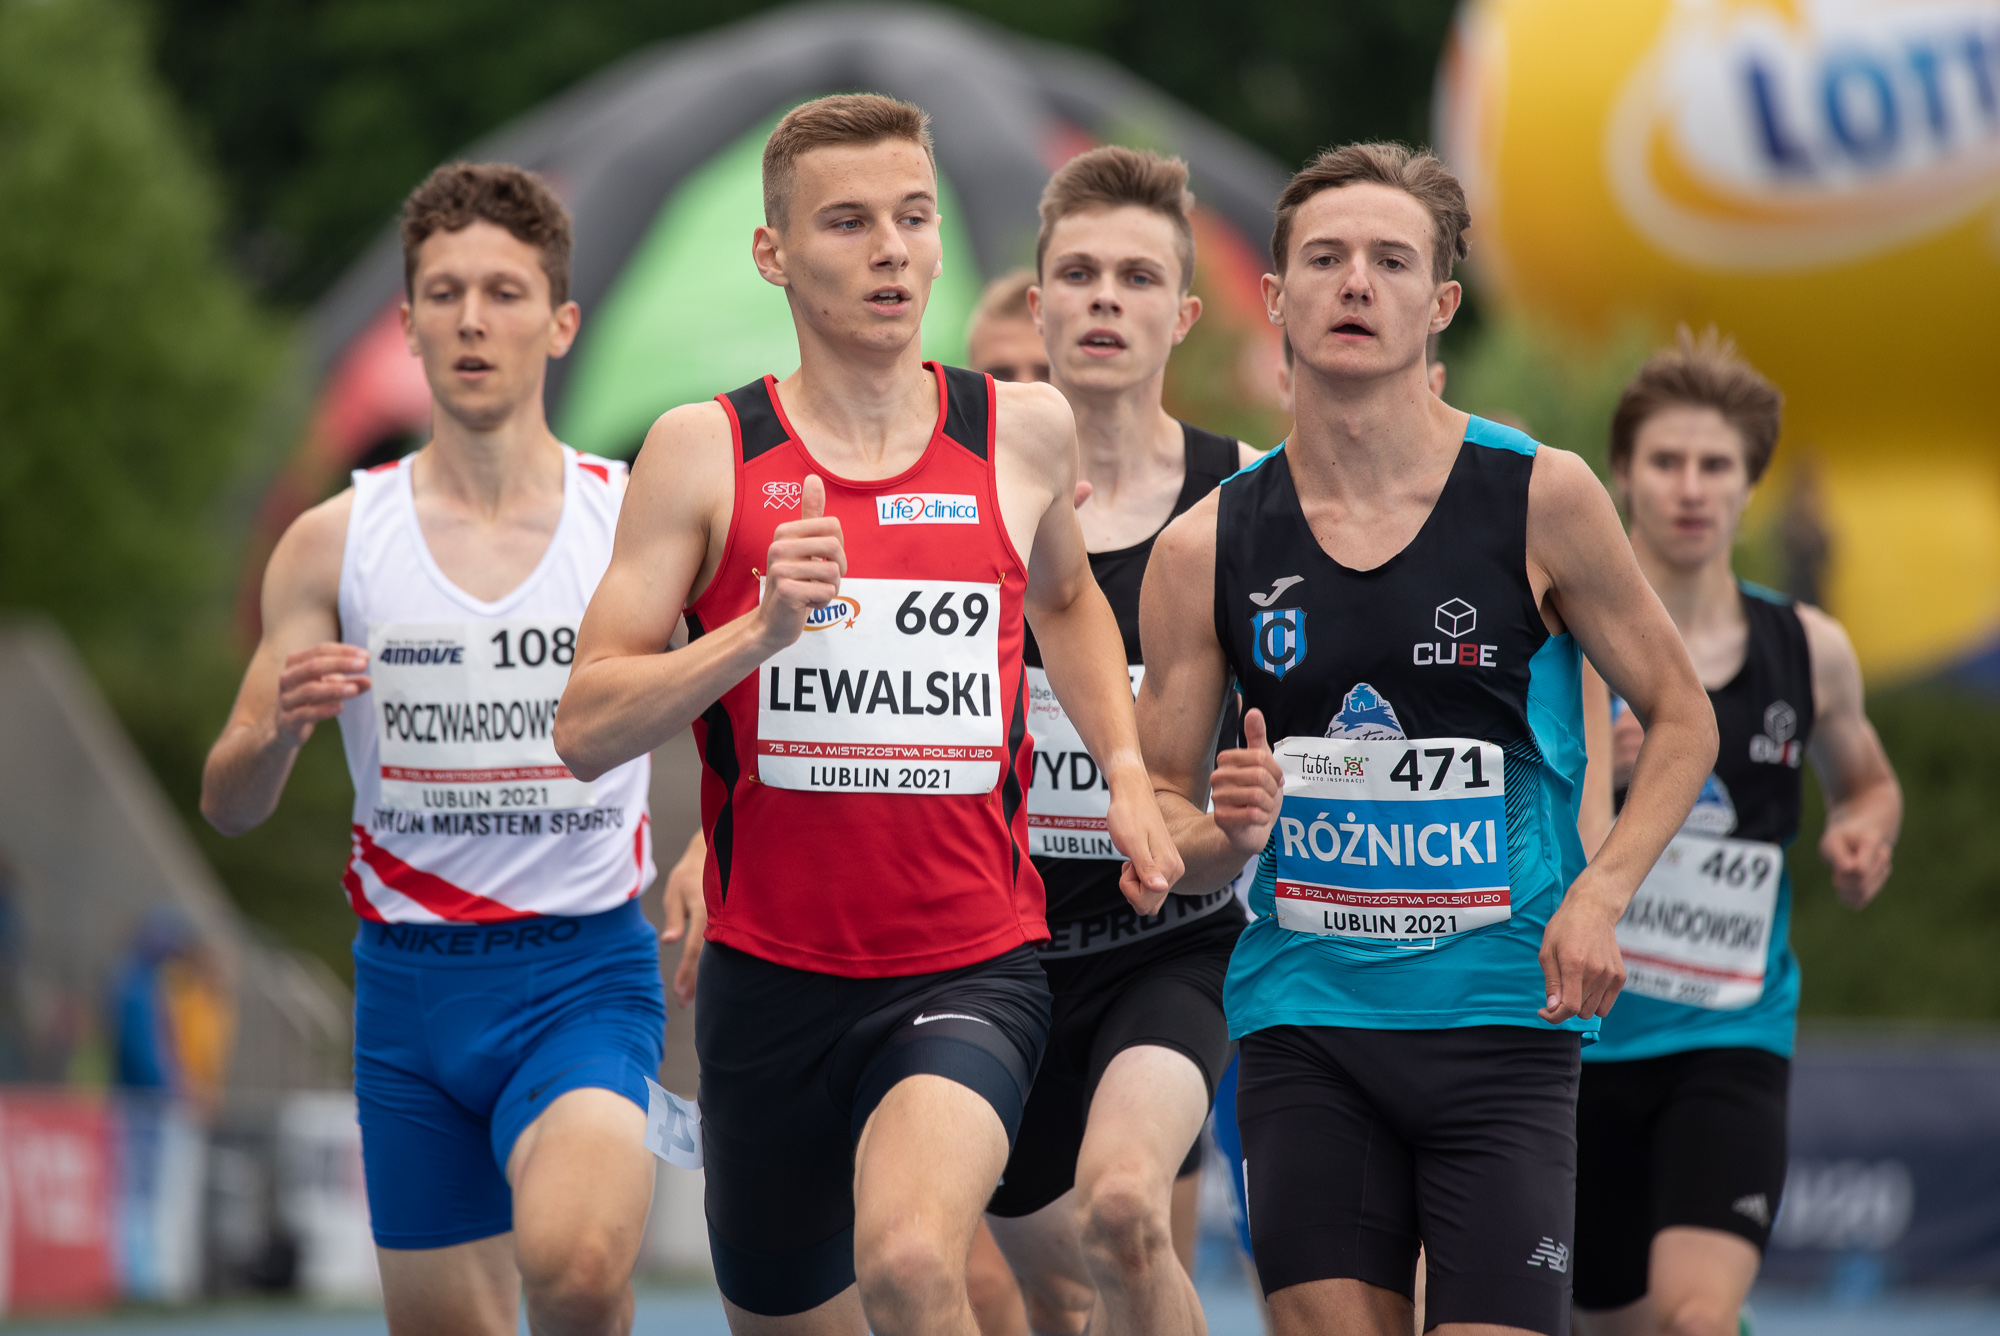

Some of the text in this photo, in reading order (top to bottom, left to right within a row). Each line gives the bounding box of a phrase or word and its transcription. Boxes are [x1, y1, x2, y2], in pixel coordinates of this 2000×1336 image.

[882, 498, 976, 519] Life clinica
[895, 591, 989, 637] 669
[379, 647, 465, 665] 4MOVE
[491, 627, 576, 669] 108
[1413, 643, 1498, 668] CUBE
[769, 666, 992, 717] LEWALSKI
[769, 743, 993, 759] 75. PZLA MISTRZOSTWA POLSKI U20
[1029, 751, 1110, 791] YD
[1284, 753, 1342, 776] lublin
[1389, 746, 1490, 791] 471
[810, 766, 951, 789] LUBLIN 2021
[422, 787, 549, 808] LUBLIN 2021
[432, 813, 542, 836] MIASTEM
[1043, 835, 1114, 855] LUBLIN
[1280, 811, 1498, 867] RÓŻNICKI
[1700, 849, 1772, 892] 469
[1285, 886, 1501, 905] 75. PZLA MISTRZOSTWA POLSKI U20
[1323, 910, 1457, 934] LUBLIN 2021
[378, 918, 581, 956] NIKE PRO
